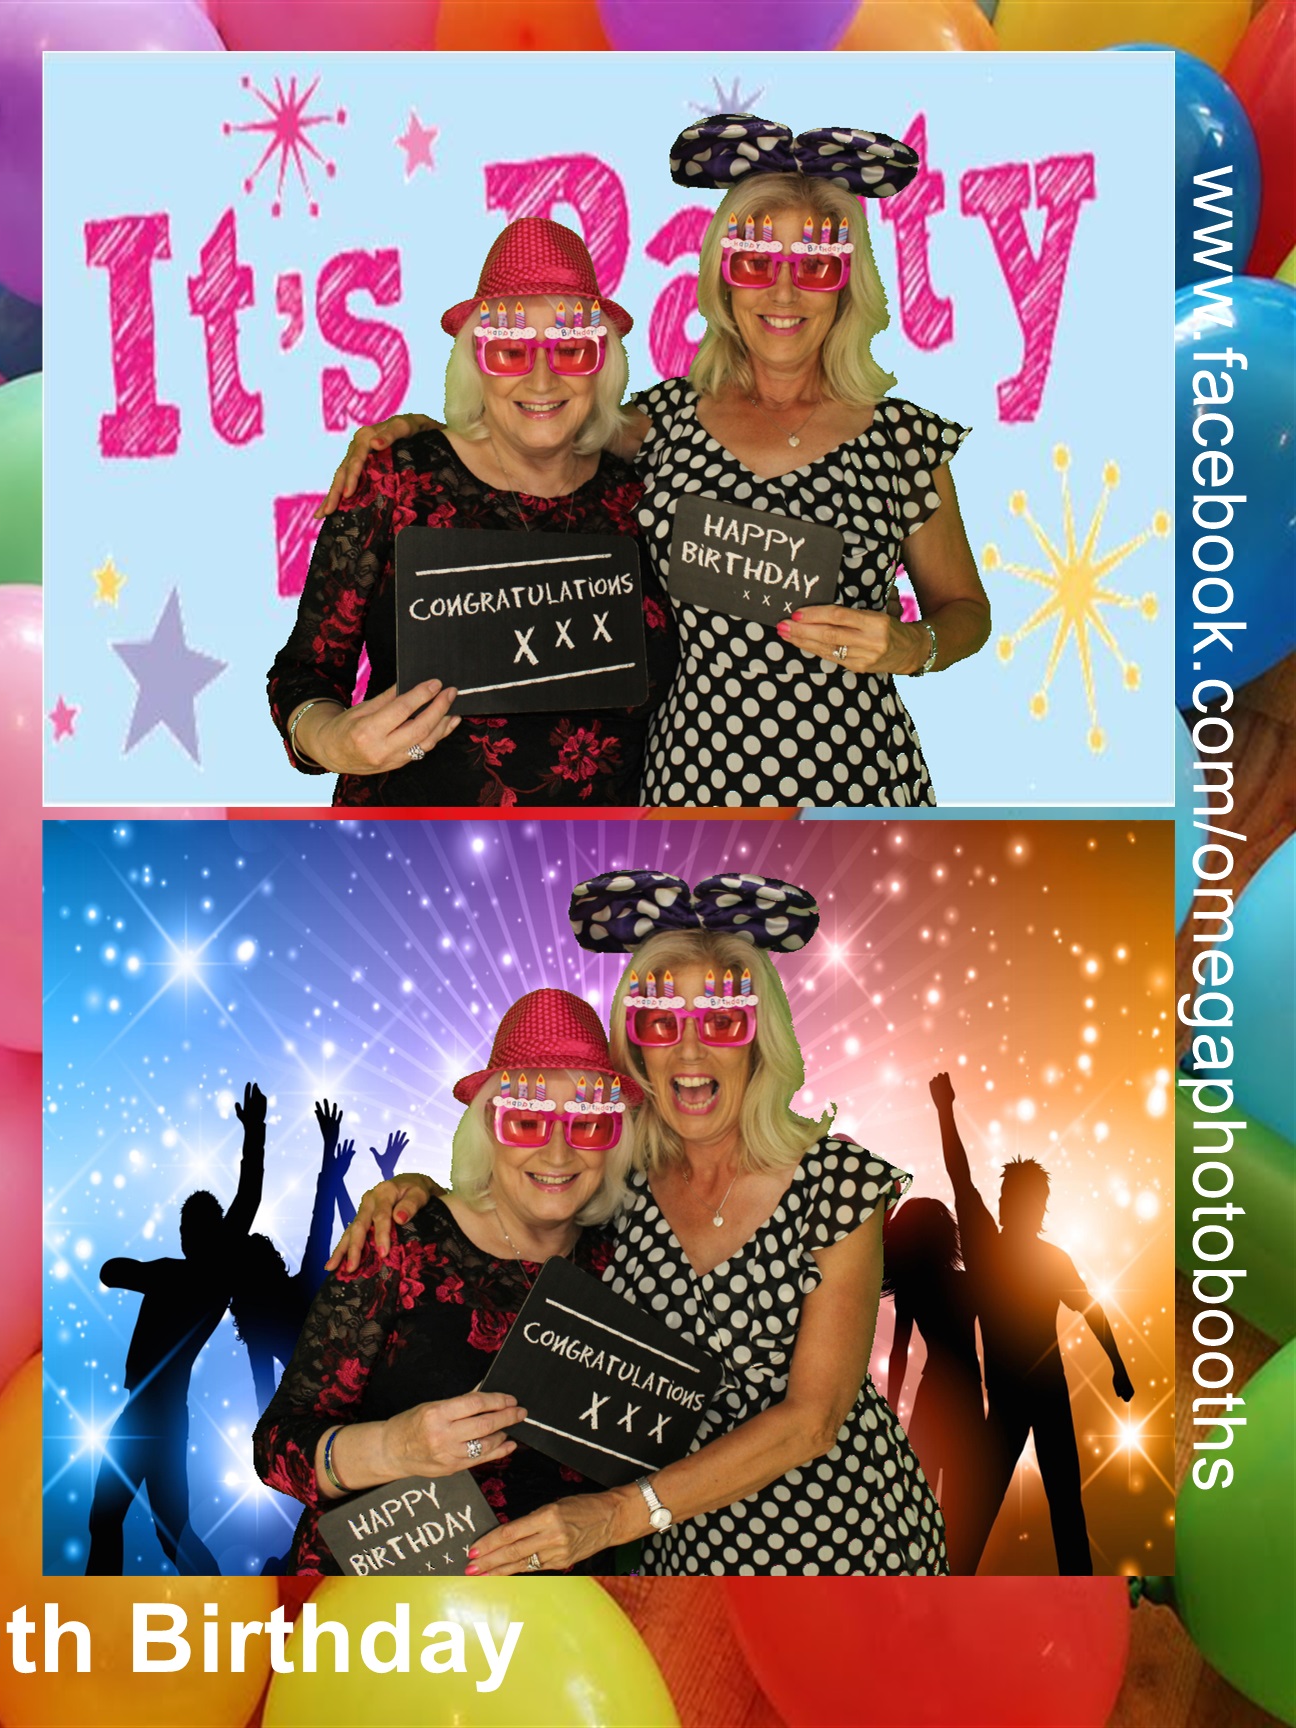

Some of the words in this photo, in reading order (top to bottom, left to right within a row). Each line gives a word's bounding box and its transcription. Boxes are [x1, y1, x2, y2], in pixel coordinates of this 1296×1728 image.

[82, 207, 412, 459] It's
[484, 112, 1097, 424] Pty
[704, 514, 805, 561] HAPPY
[348, 1482, 440, 1540] HAPPY
